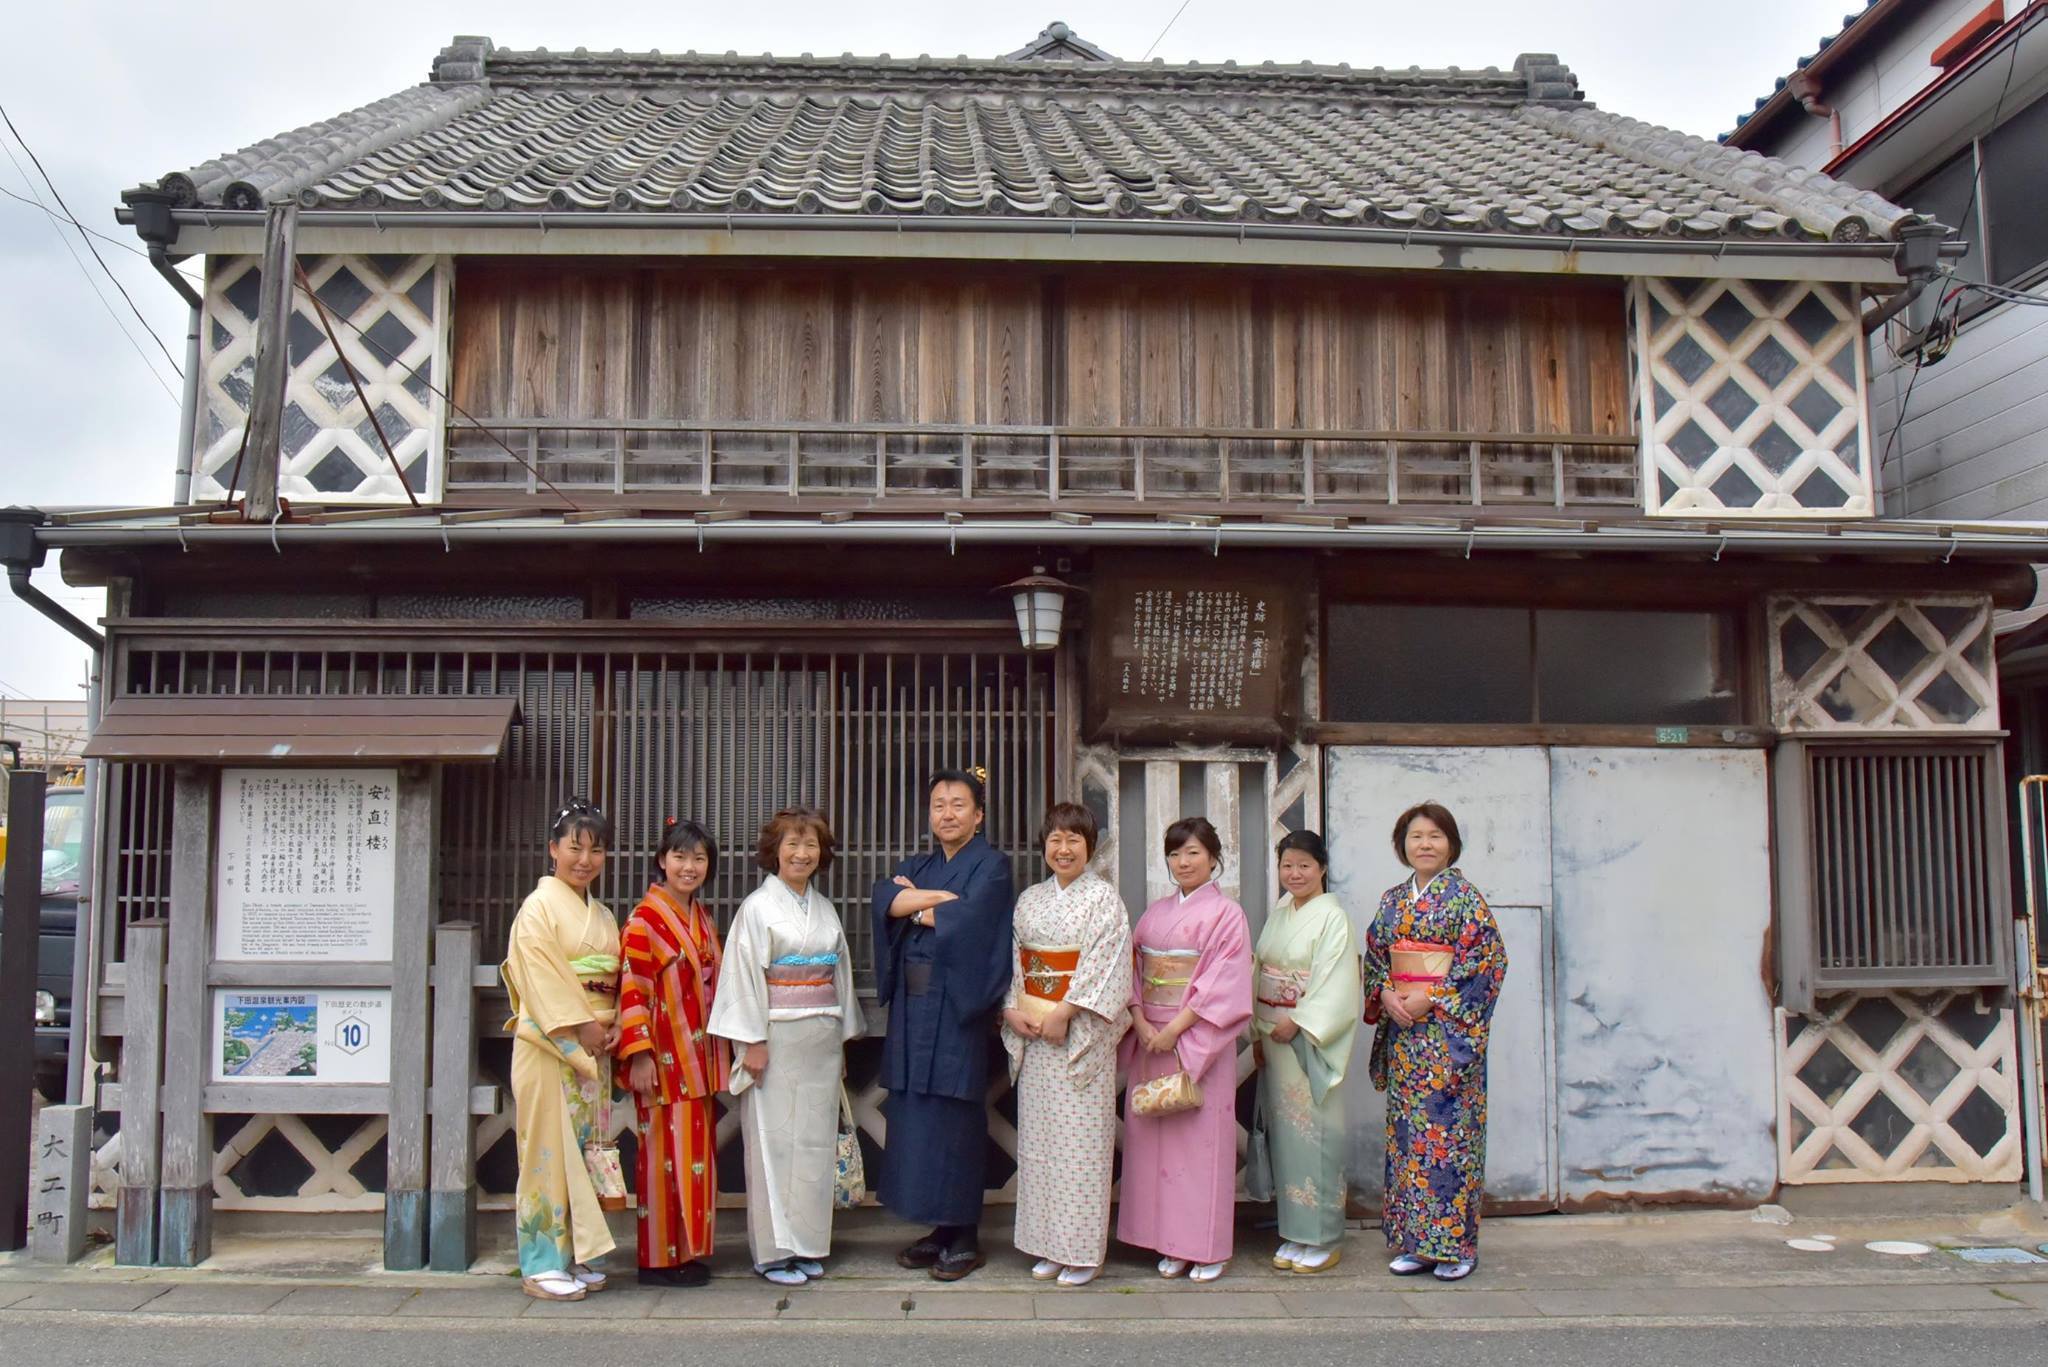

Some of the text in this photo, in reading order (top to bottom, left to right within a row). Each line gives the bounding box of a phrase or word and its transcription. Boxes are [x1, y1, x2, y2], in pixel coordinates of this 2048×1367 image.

[1254, 600, 1266, 622] 史跡
[1660, 733, 1683, 743] 5-21
[366, 784, 384, 851] 安直楼
[342, 1024, 361, 1047] 10
[37, 1134, 68, 1236] 大工町
